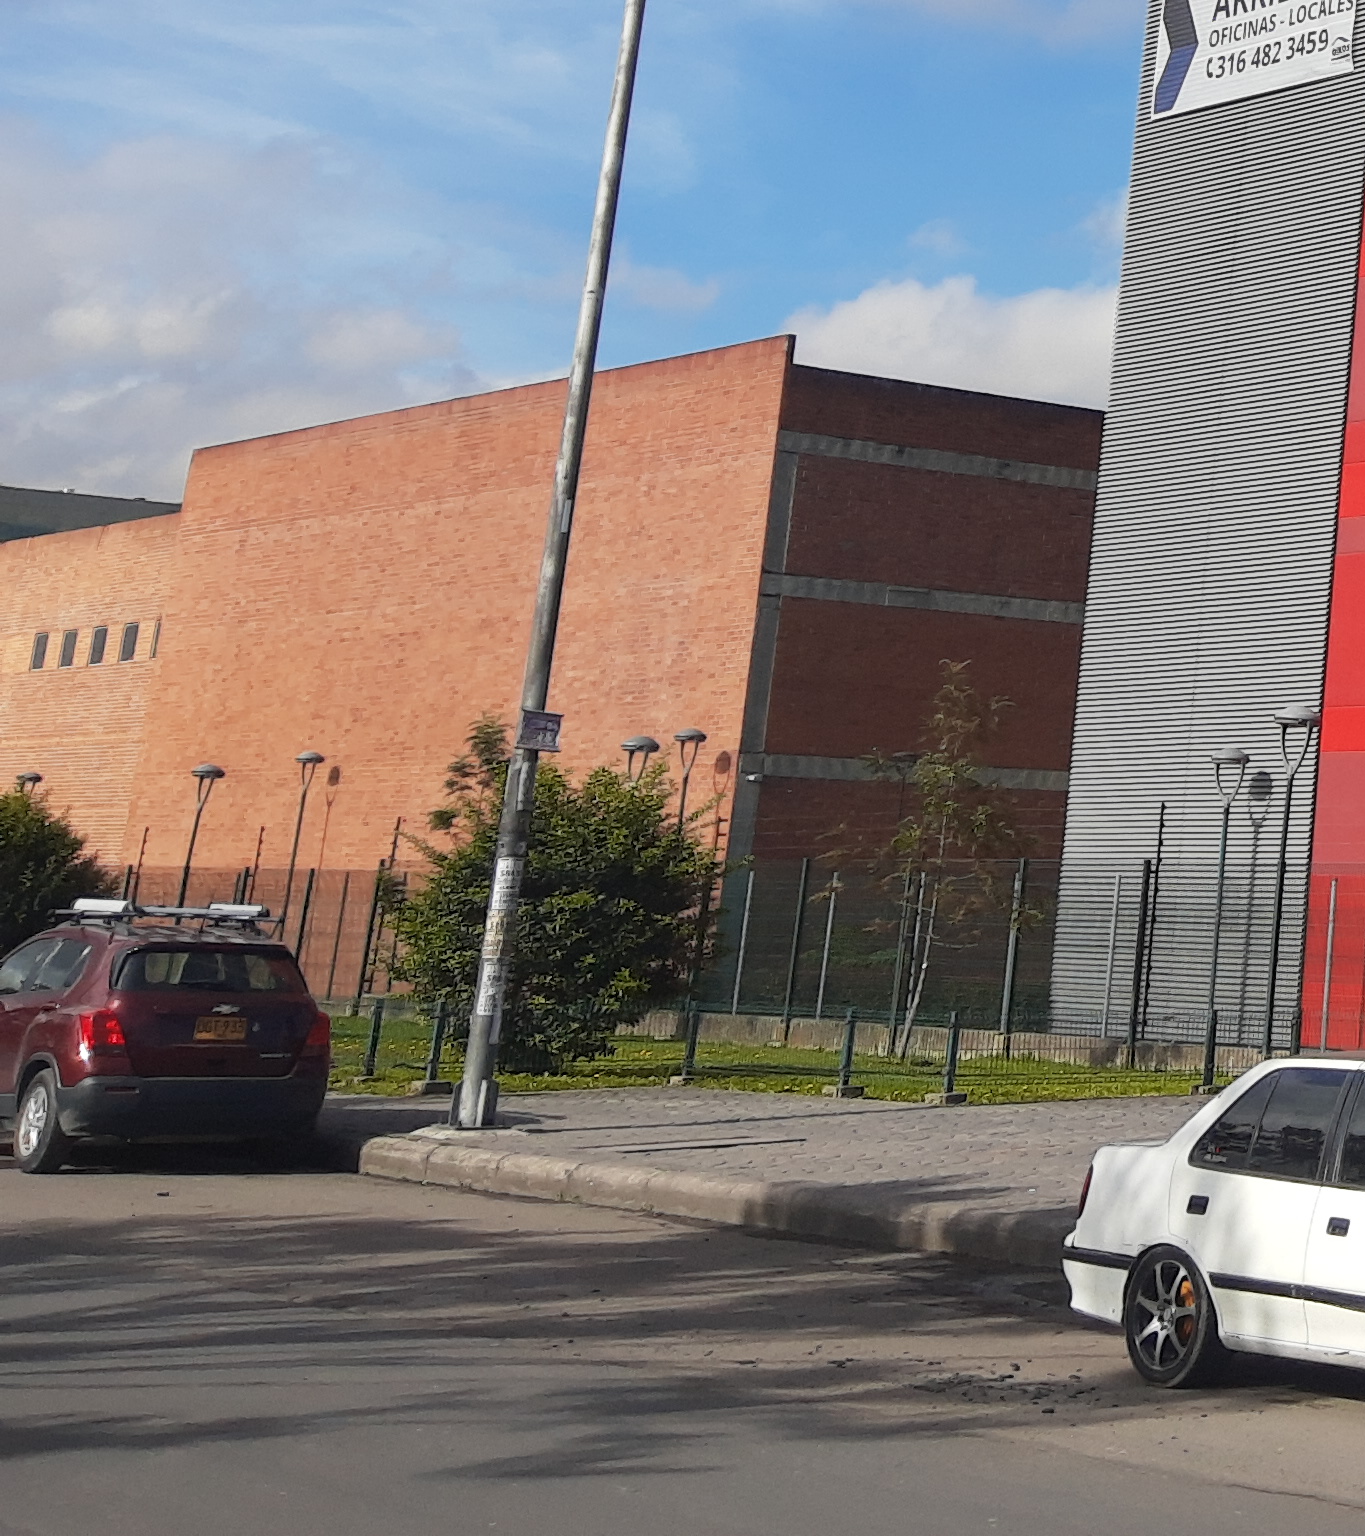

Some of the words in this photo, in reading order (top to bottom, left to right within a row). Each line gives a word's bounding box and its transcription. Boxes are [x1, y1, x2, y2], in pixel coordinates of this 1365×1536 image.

[1208, 13, 1277, 48] OFICINAS
[1215, 50, 1247, 79] 316
[1251, 41, 1281, 68] 482
[1286, 29, 1329, 60] 3459
